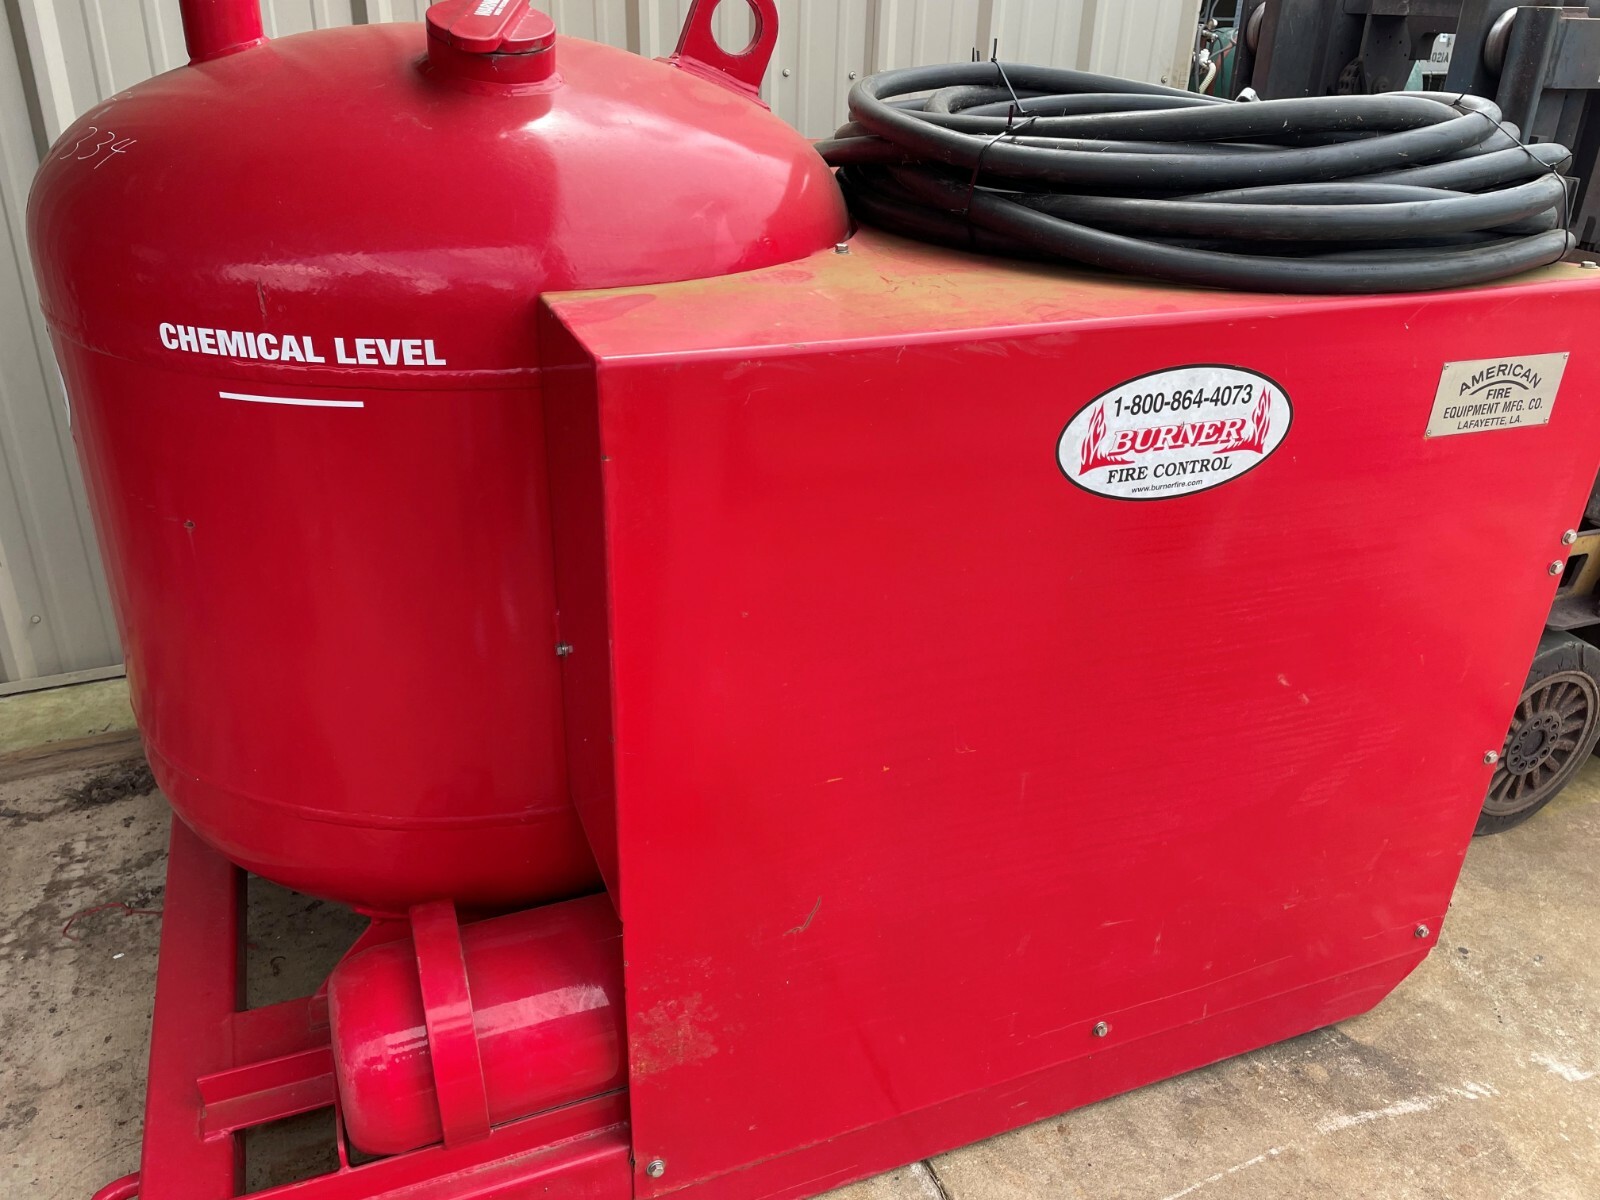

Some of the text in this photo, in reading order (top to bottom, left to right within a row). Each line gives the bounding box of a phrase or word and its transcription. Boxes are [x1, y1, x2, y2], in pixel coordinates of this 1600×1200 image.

[59, 126, 137, 170] 334
[159, 322, 447, 366] CHEMICAL LEVEL
[1459, 363, 1542, 396] AMERICAN
[1486, 387, 1512, 400] FIRE
[1114, 384, 1253, 417] 1-800-864-4073
[1443, 397, 1543, 419] EQUIPMENT MFG. CO.
[1108, 418, 1246, 456] BURNER
[1457, 414, 1522, 430] LAFAYETTE, LA.
[1106, 456, 1232, 484] FIRE CONTROL
[1131, 478, 1203, 494] www.burnerfire.com
